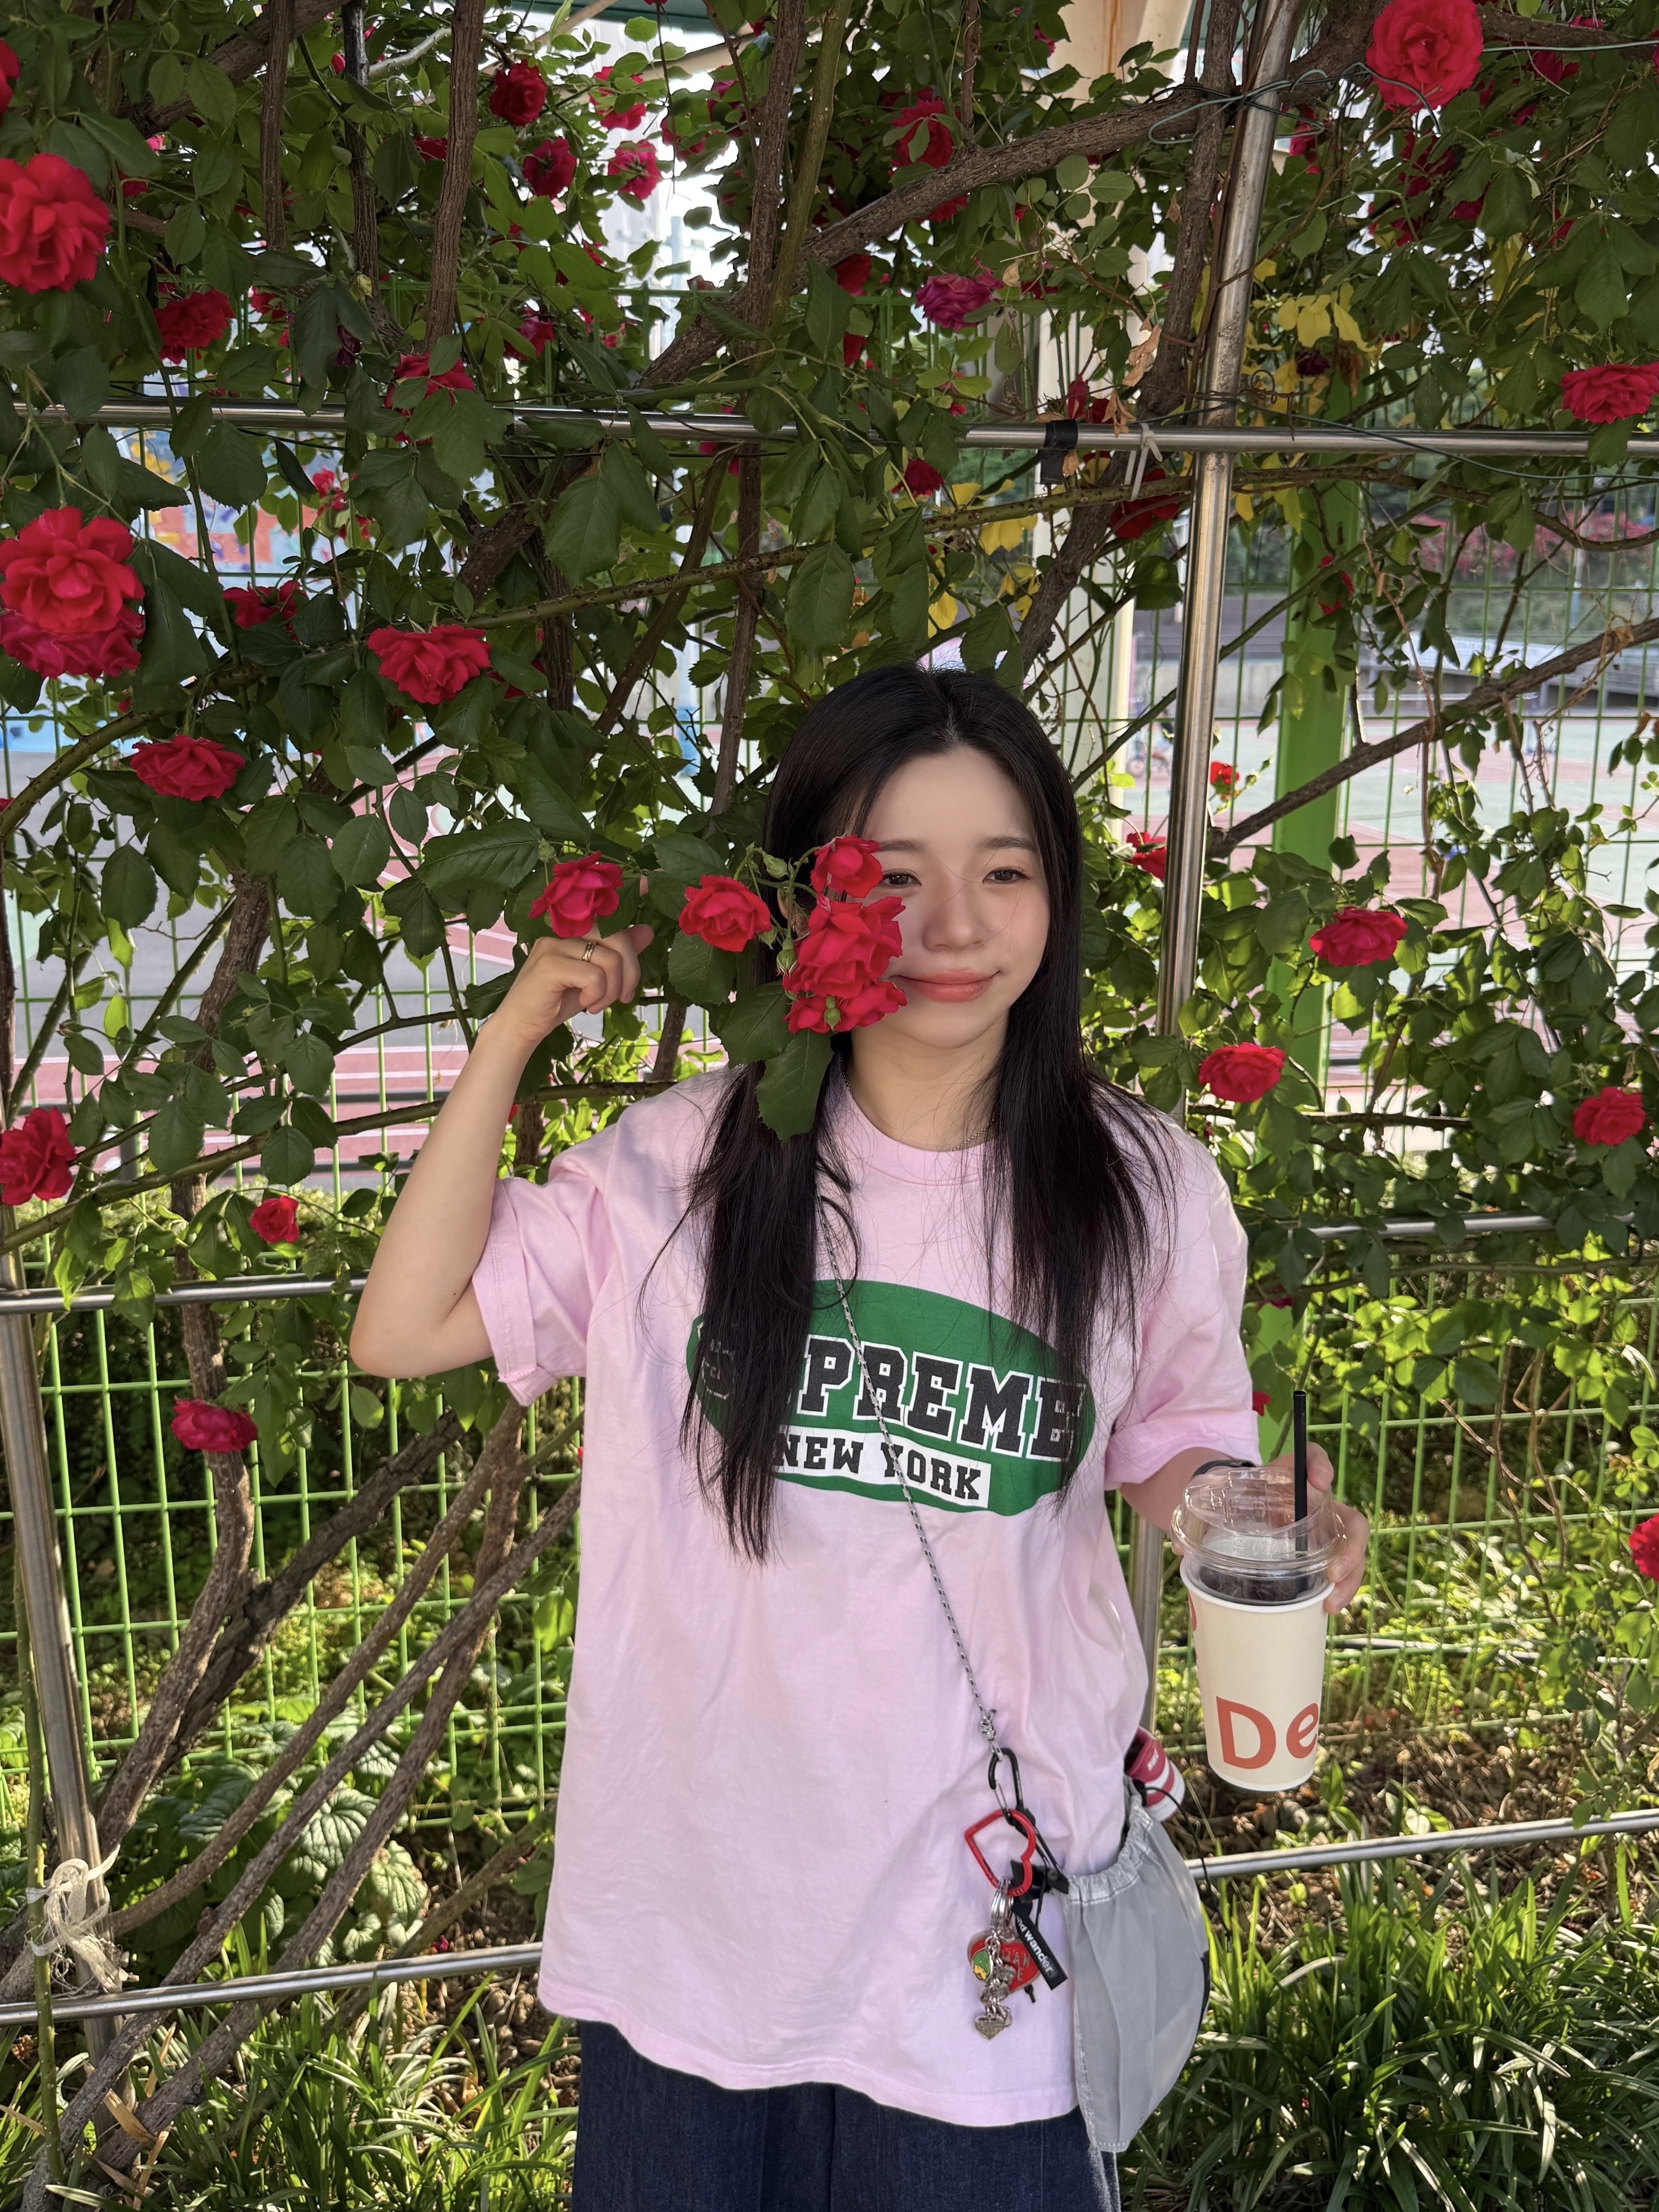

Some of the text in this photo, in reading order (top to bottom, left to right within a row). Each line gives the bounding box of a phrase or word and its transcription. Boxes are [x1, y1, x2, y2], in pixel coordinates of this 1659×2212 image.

[772, 1433, 981, 1500] NEW YORK
[1216, 1696, 1319, 1769] De
